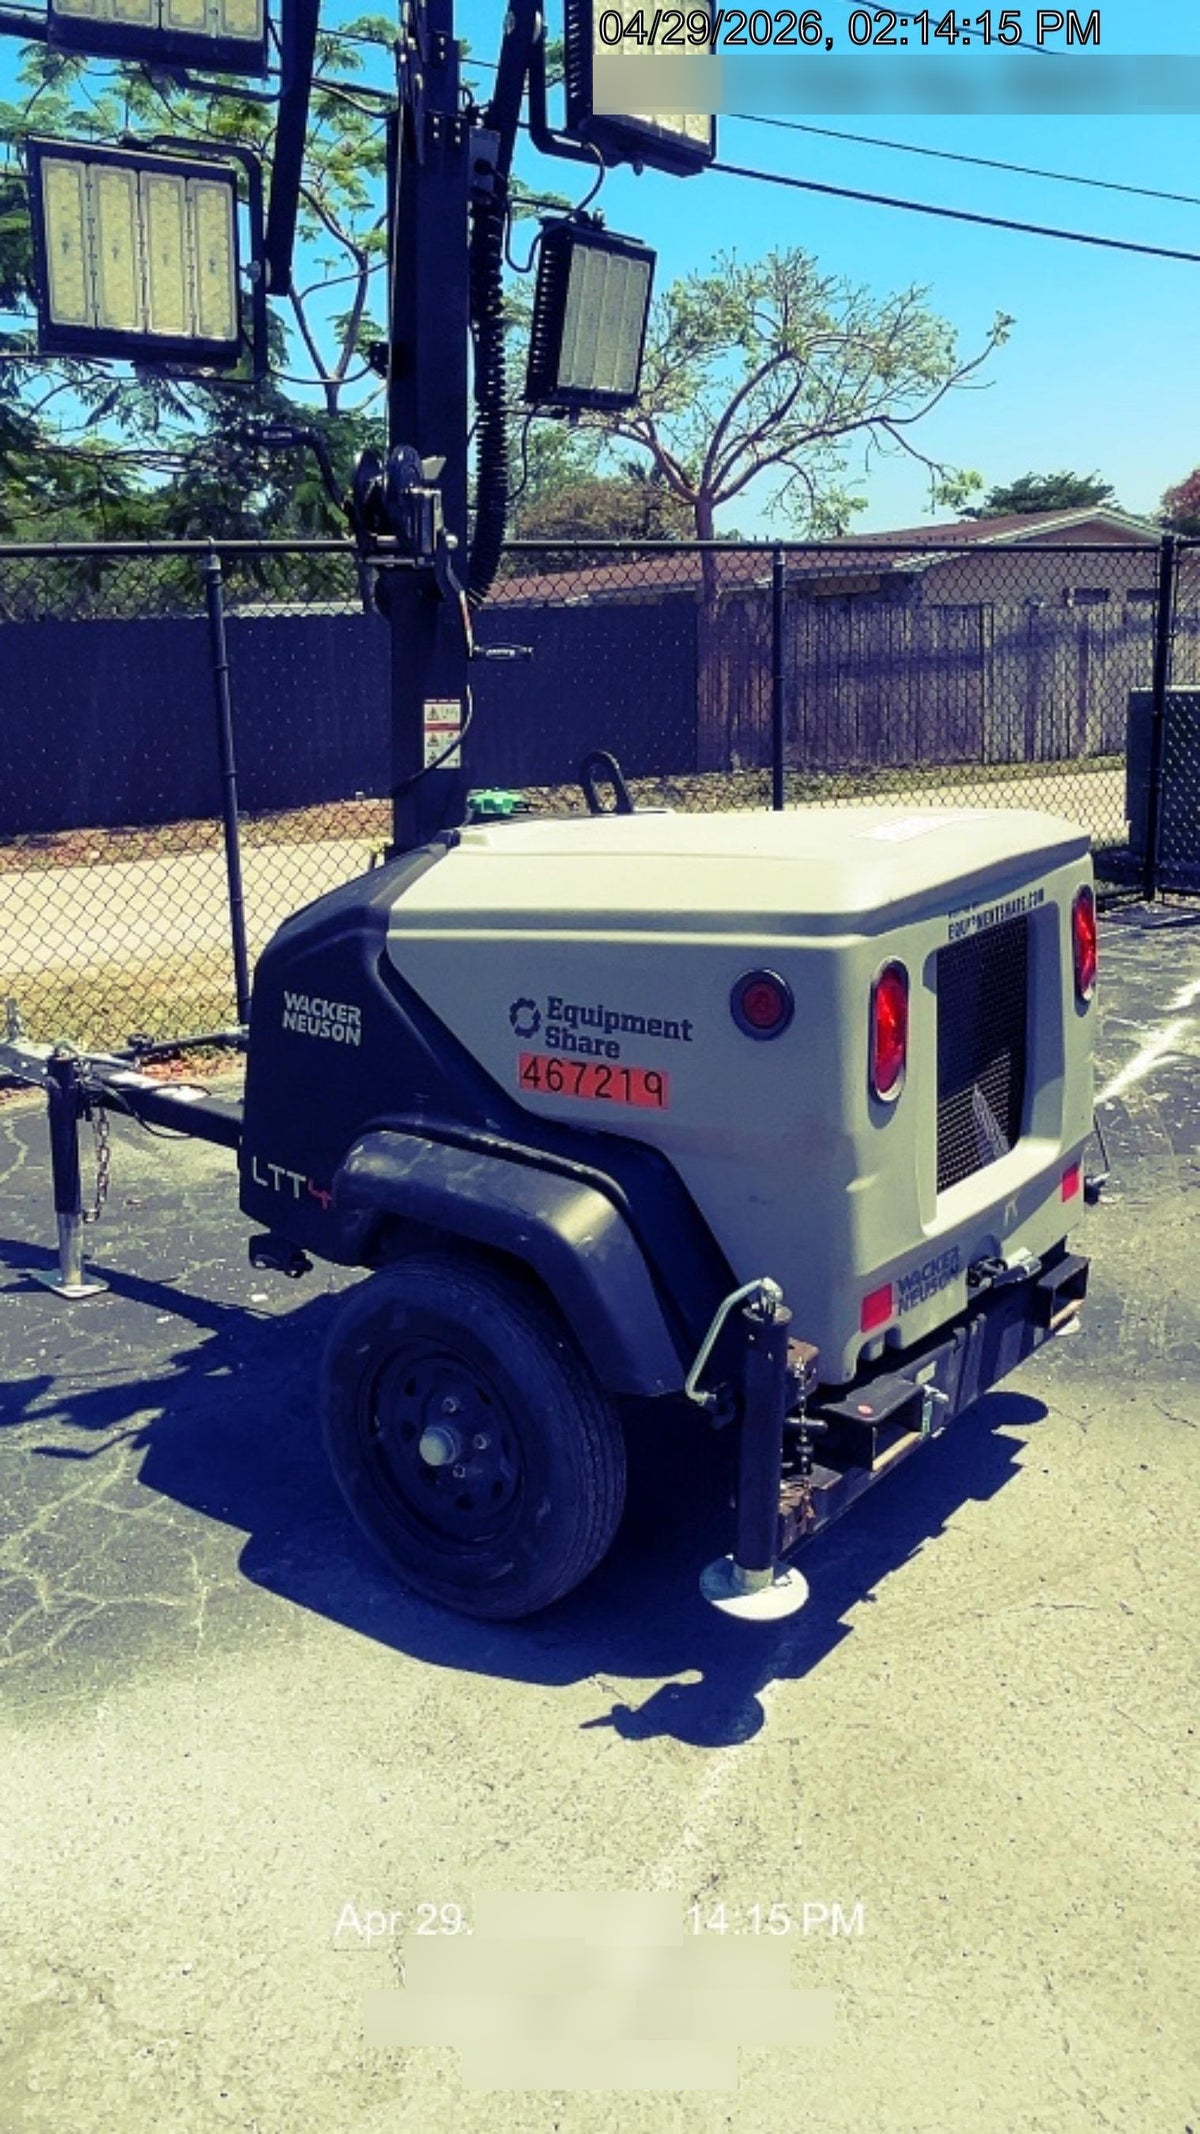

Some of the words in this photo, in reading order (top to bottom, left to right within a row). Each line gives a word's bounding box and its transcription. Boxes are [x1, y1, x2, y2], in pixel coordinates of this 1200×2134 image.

[282, 1013, 361, 1047] NEUSON
[283, 990, 361, 1026] WACKER
[546, 995, 693, 1042] Equipment
[545, 1026, 621, 1059] Share
[522, 1056, 663, 1107] 467219
[252, 1155, 334, 1210] LTT4
[897, 1244, 960, 1294] WACKER
[898, 1264, 959, 1317] NEUSON
